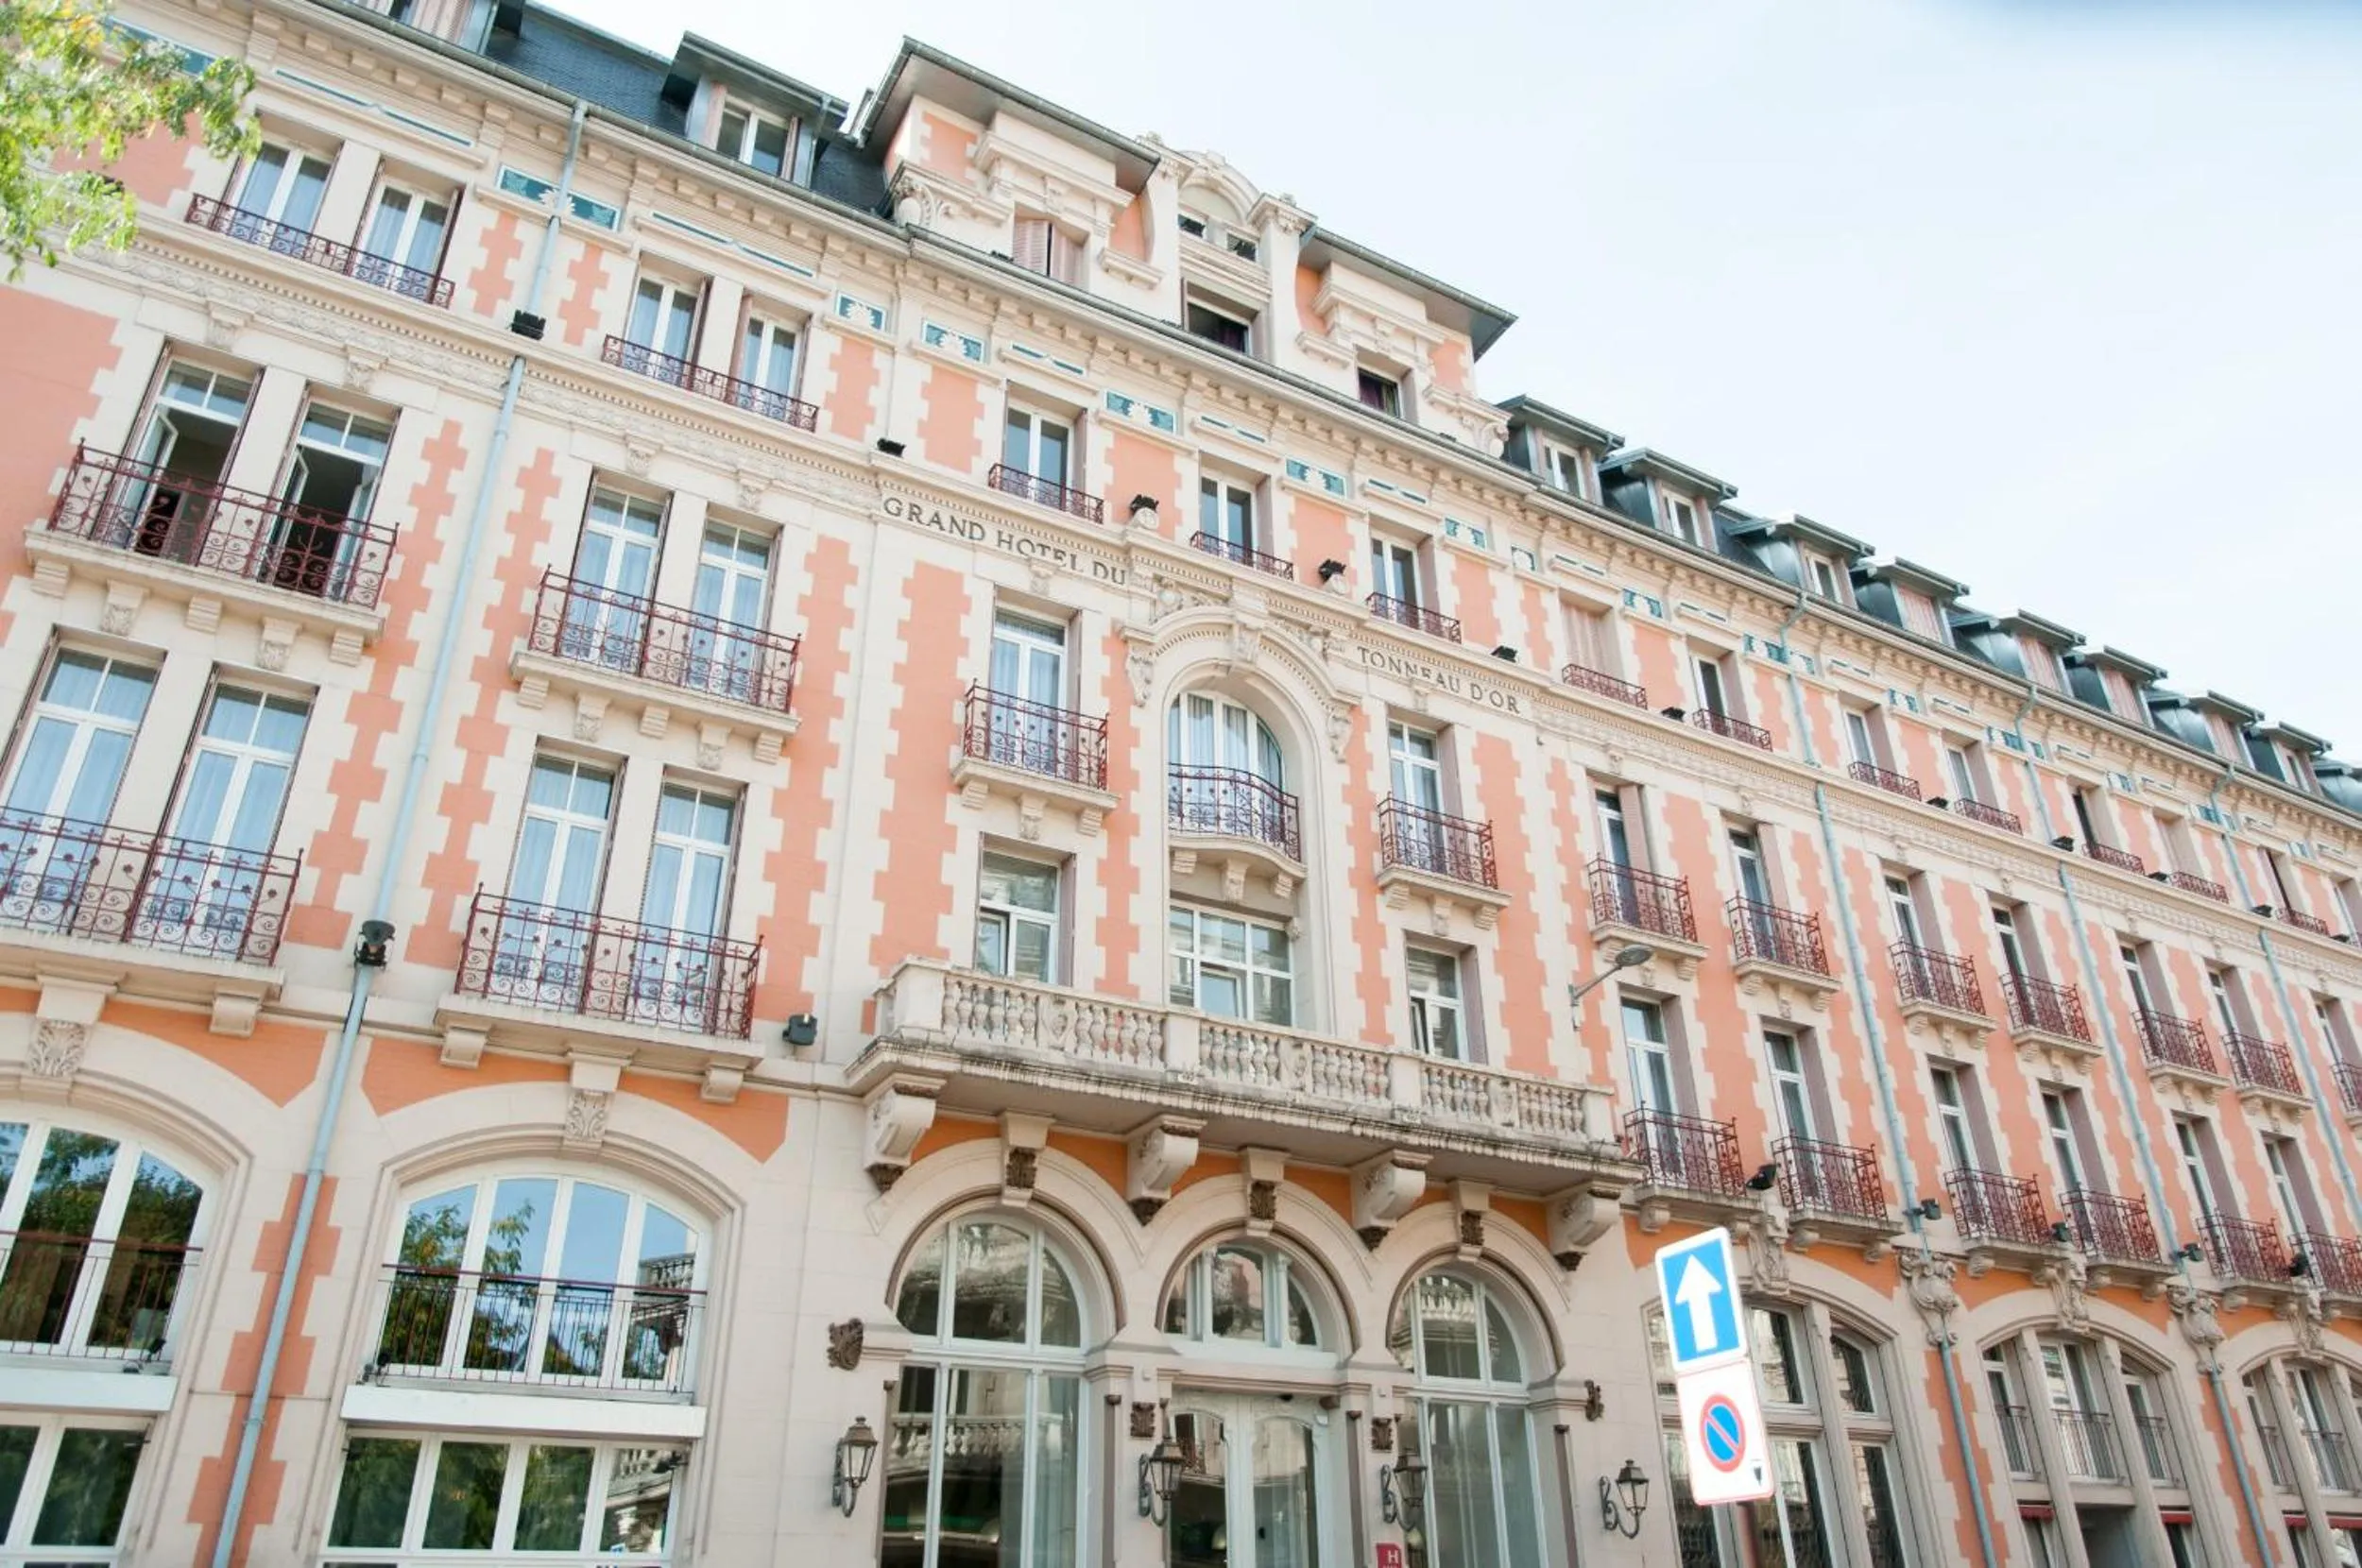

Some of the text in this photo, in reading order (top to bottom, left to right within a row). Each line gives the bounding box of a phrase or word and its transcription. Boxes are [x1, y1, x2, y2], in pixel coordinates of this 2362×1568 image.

[883, 497, 1128, 586] GRAND HOTEL DU
[1357, 646, 1520, 714] TONNEAU D'OR
[1388, 1549, 1399, 1563] H
